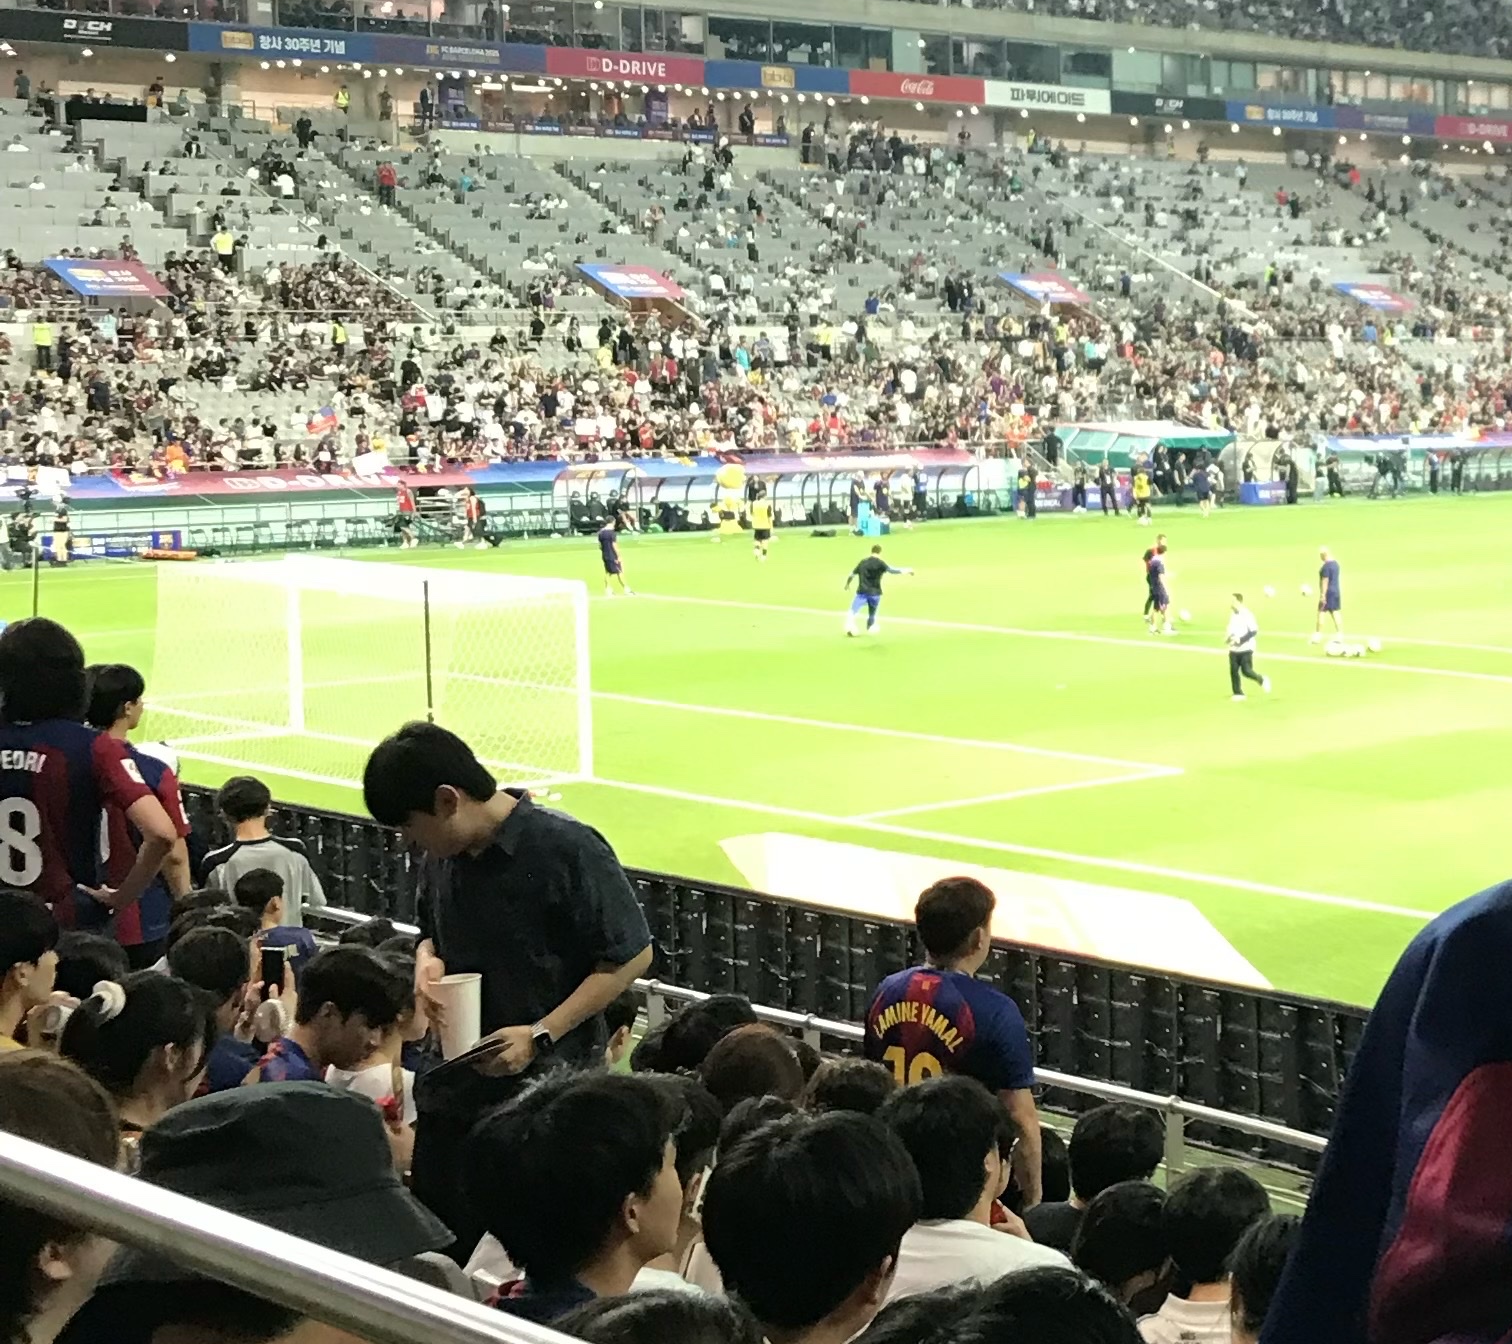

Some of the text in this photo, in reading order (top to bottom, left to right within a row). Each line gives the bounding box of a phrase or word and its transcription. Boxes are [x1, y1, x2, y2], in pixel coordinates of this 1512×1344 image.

[259, 35, 282, 50] 창사
[285, 38, 322, 53] 30주년
[323, 39, 346, 54] 기념
[602, 58, 666, 77] D-DRIVE
[1010, 87, 1085, 106] 파워에이드
[0, 750, 47, 774] EDRI
[0, 797, 43, 886] 8
[873, 1001, 964, 1054] LAMINE YAMAL
